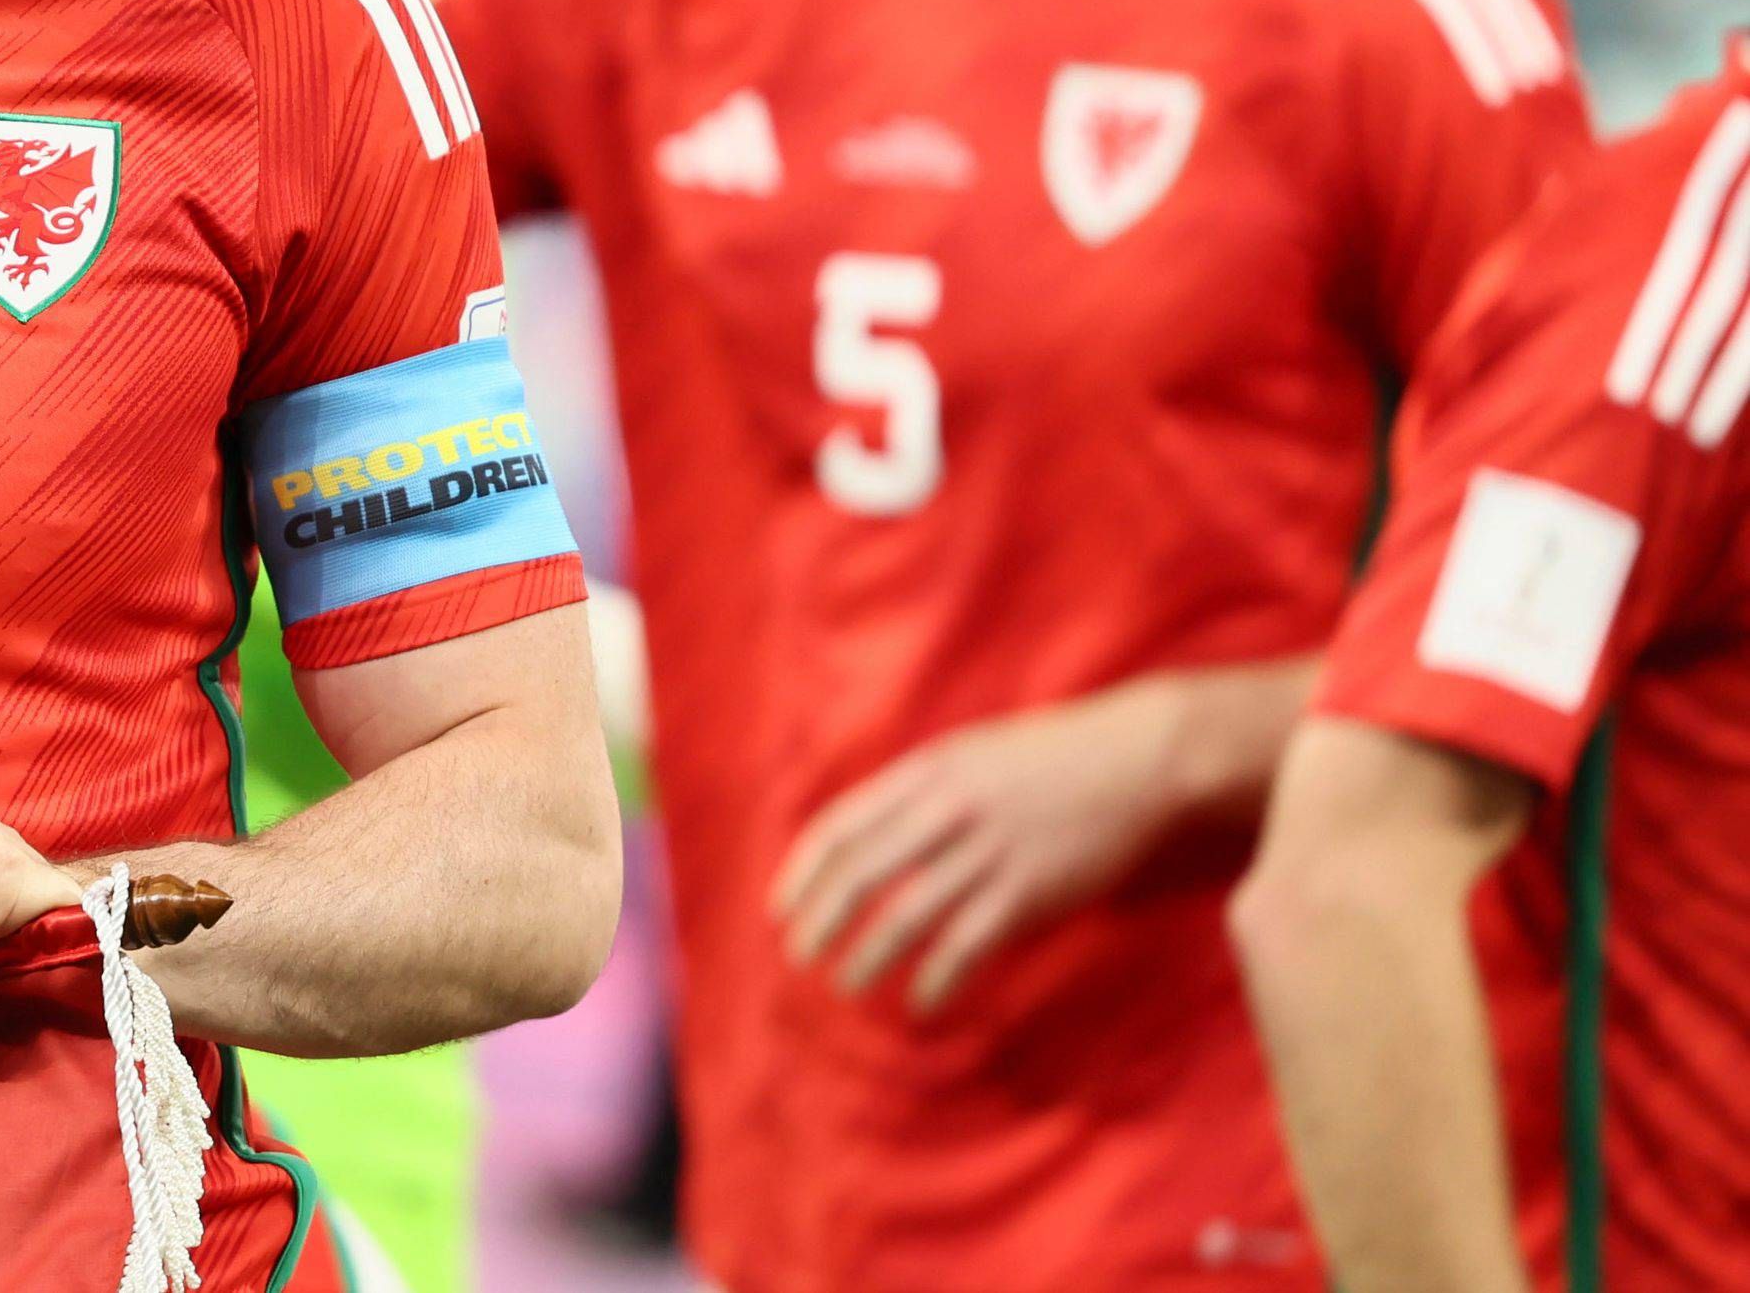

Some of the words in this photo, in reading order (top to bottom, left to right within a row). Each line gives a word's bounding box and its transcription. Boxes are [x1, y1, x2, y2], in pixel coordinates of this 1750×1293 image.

[814, 249, 944, 520] 5
[271, 411, 533, 510] PROTECT
[283, 453, 549, 550] CHILDREN
